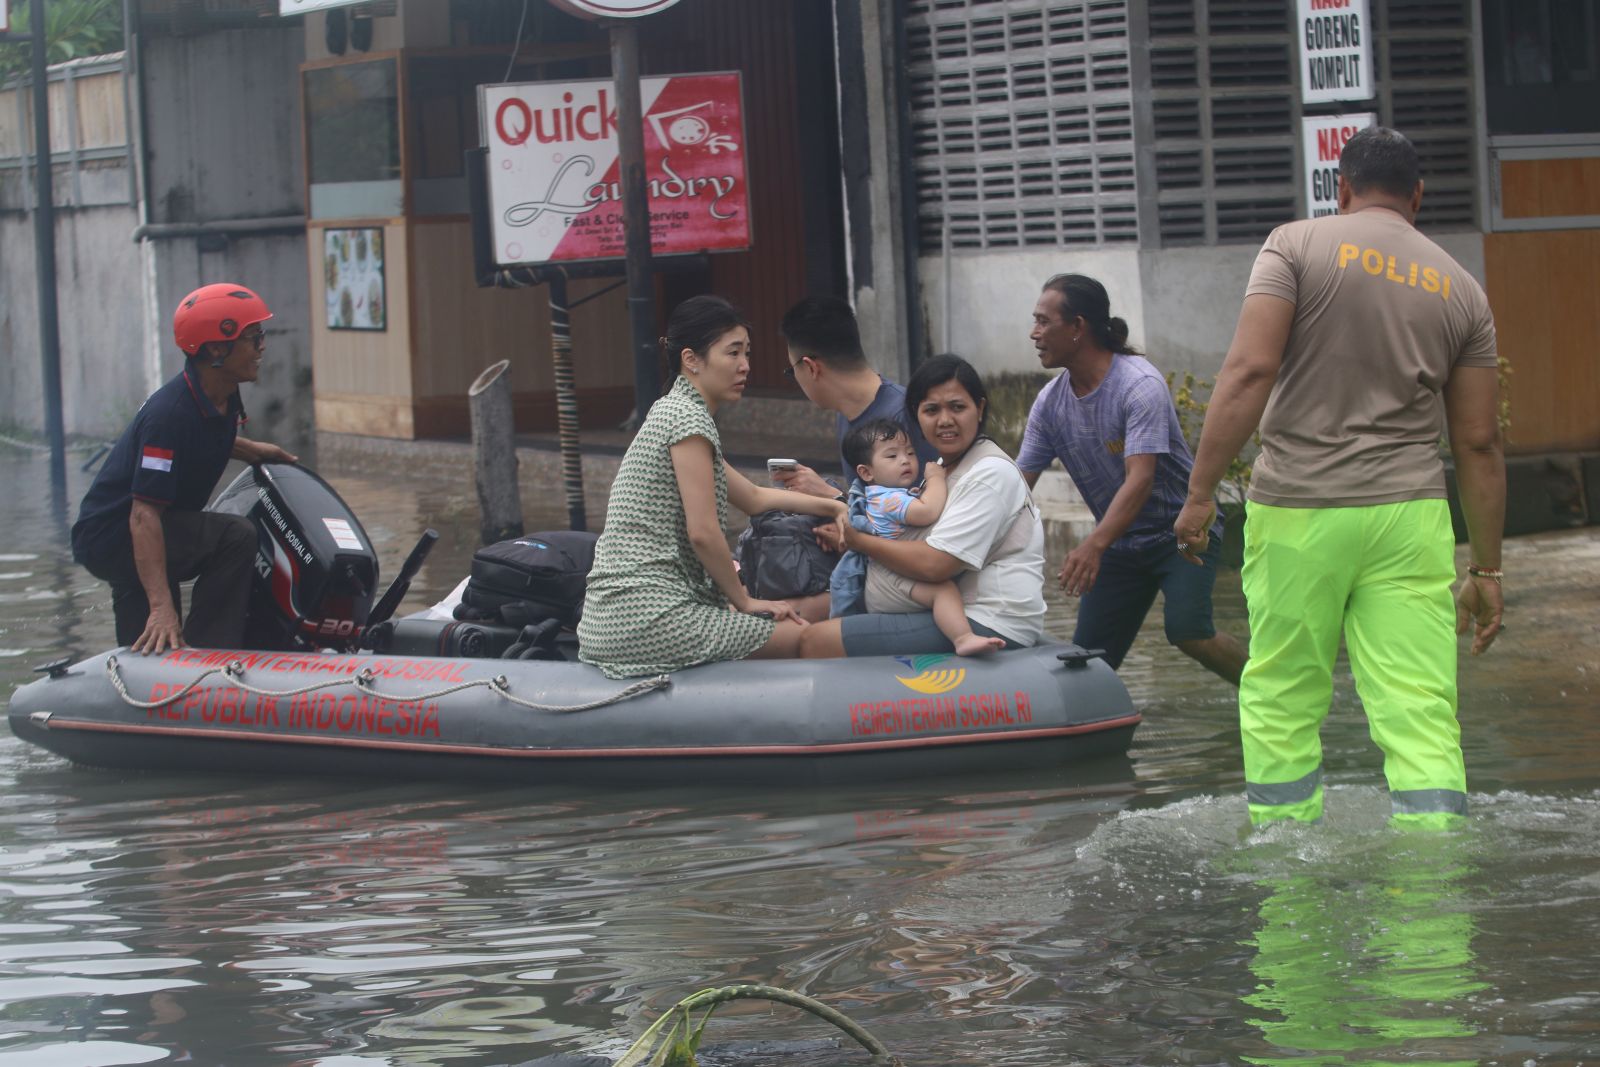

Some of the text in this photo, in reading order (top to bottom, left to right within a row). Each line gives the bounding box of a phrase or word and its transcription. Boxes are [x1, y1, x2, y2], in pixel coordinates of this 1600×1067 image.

[1305, 13, 1360, 50] GORENG
[1309, 54, 1360, 90] KOMPLIT
[495, 89, 618, 147] Quick
[1317, 126, 1359, 162] NAS
[1313, 167, 1339, 202] GOR
[564, 215, 590, 228] Fast
[594, 214, 603, 225] &
[1338, 242, 1450, 300] POLISI
[257, 487, 314, 565] KEMENTERIAN SOSIAL RI
[320, 618, 354, 636] 30
[159, 649, 473, 683] KEMENTERIAN SOSIAL
[147, 682, 441, 738] REPUBLIK INDONESIA
[849, 690, 1032, 737] KEMENTERIAN SOSIAL RI
